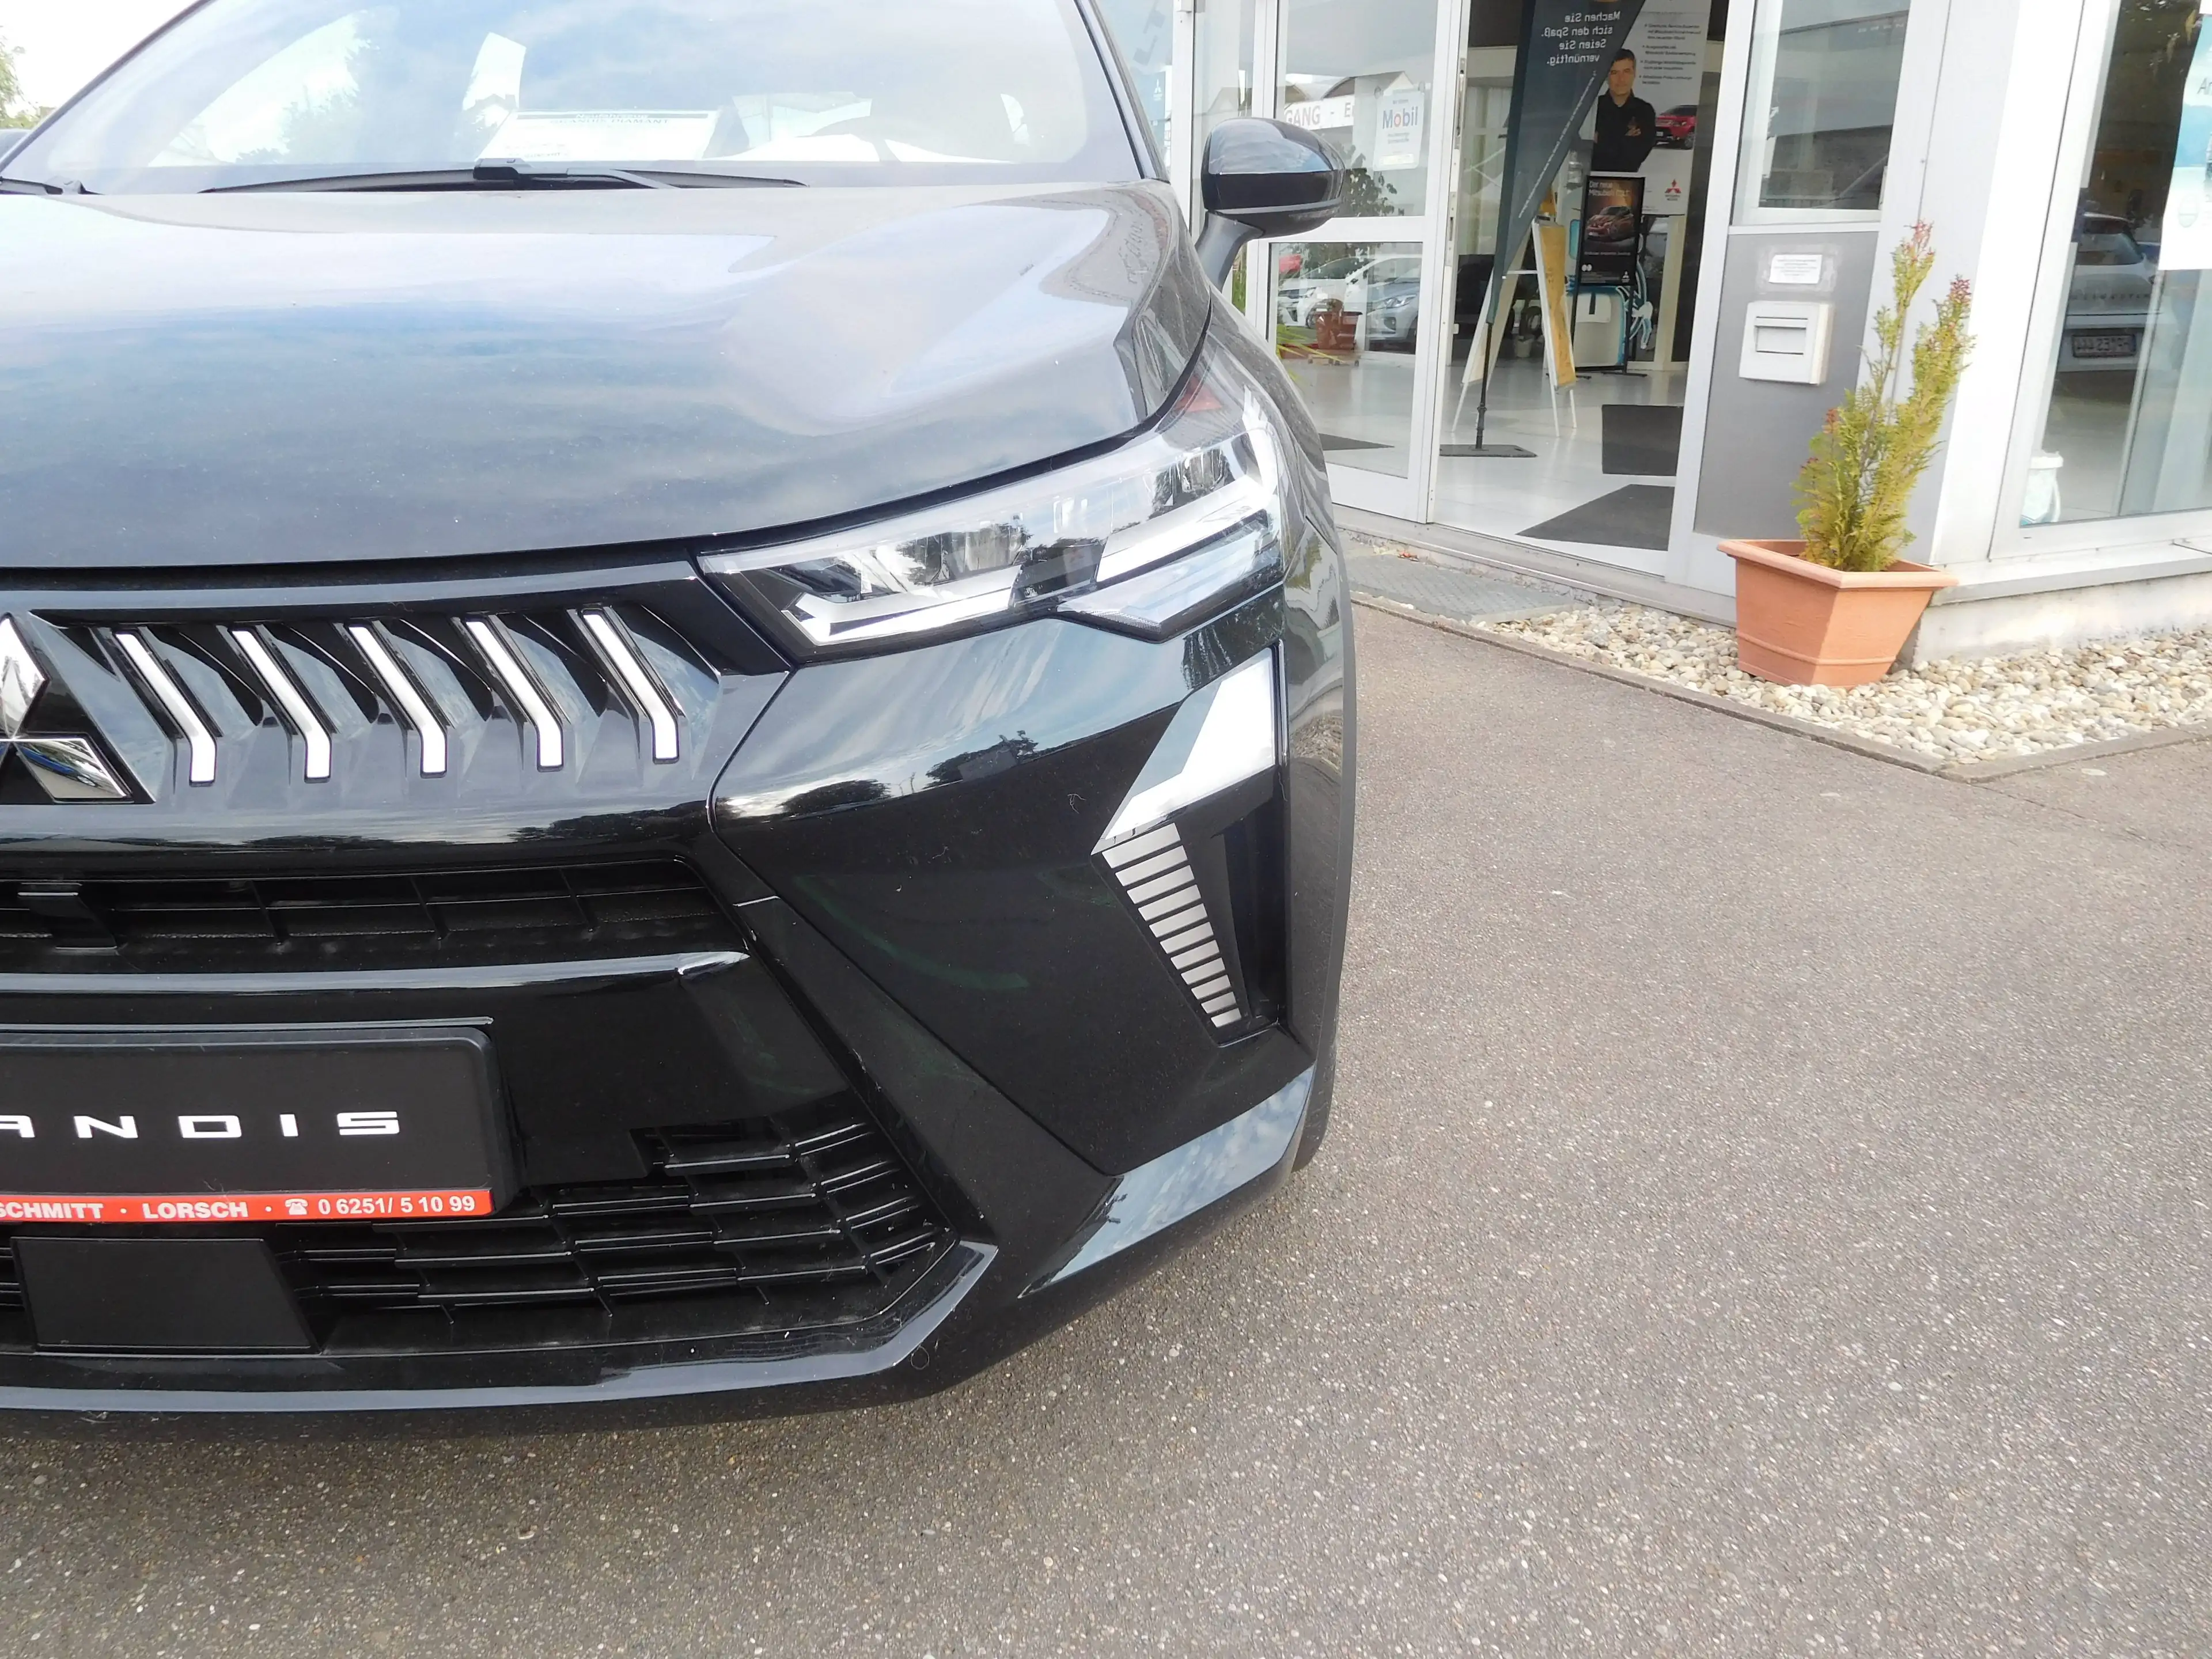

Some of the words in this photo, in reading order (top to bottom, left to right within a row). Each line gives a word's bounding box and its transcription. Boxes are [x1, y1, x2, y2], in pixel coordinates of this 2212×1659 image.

[1382, 106, 1418, 129] Mobil
[143, 1202, 248, 1219] LORSCH
[318, 1198, 331, 1215] 0
[336, 1197, 393, 1214] 6251/
[400, 1197, 413, 1213] 5
[418, 1196, 443, 1213] 10
[449, 1195, 475, 1211] 99
